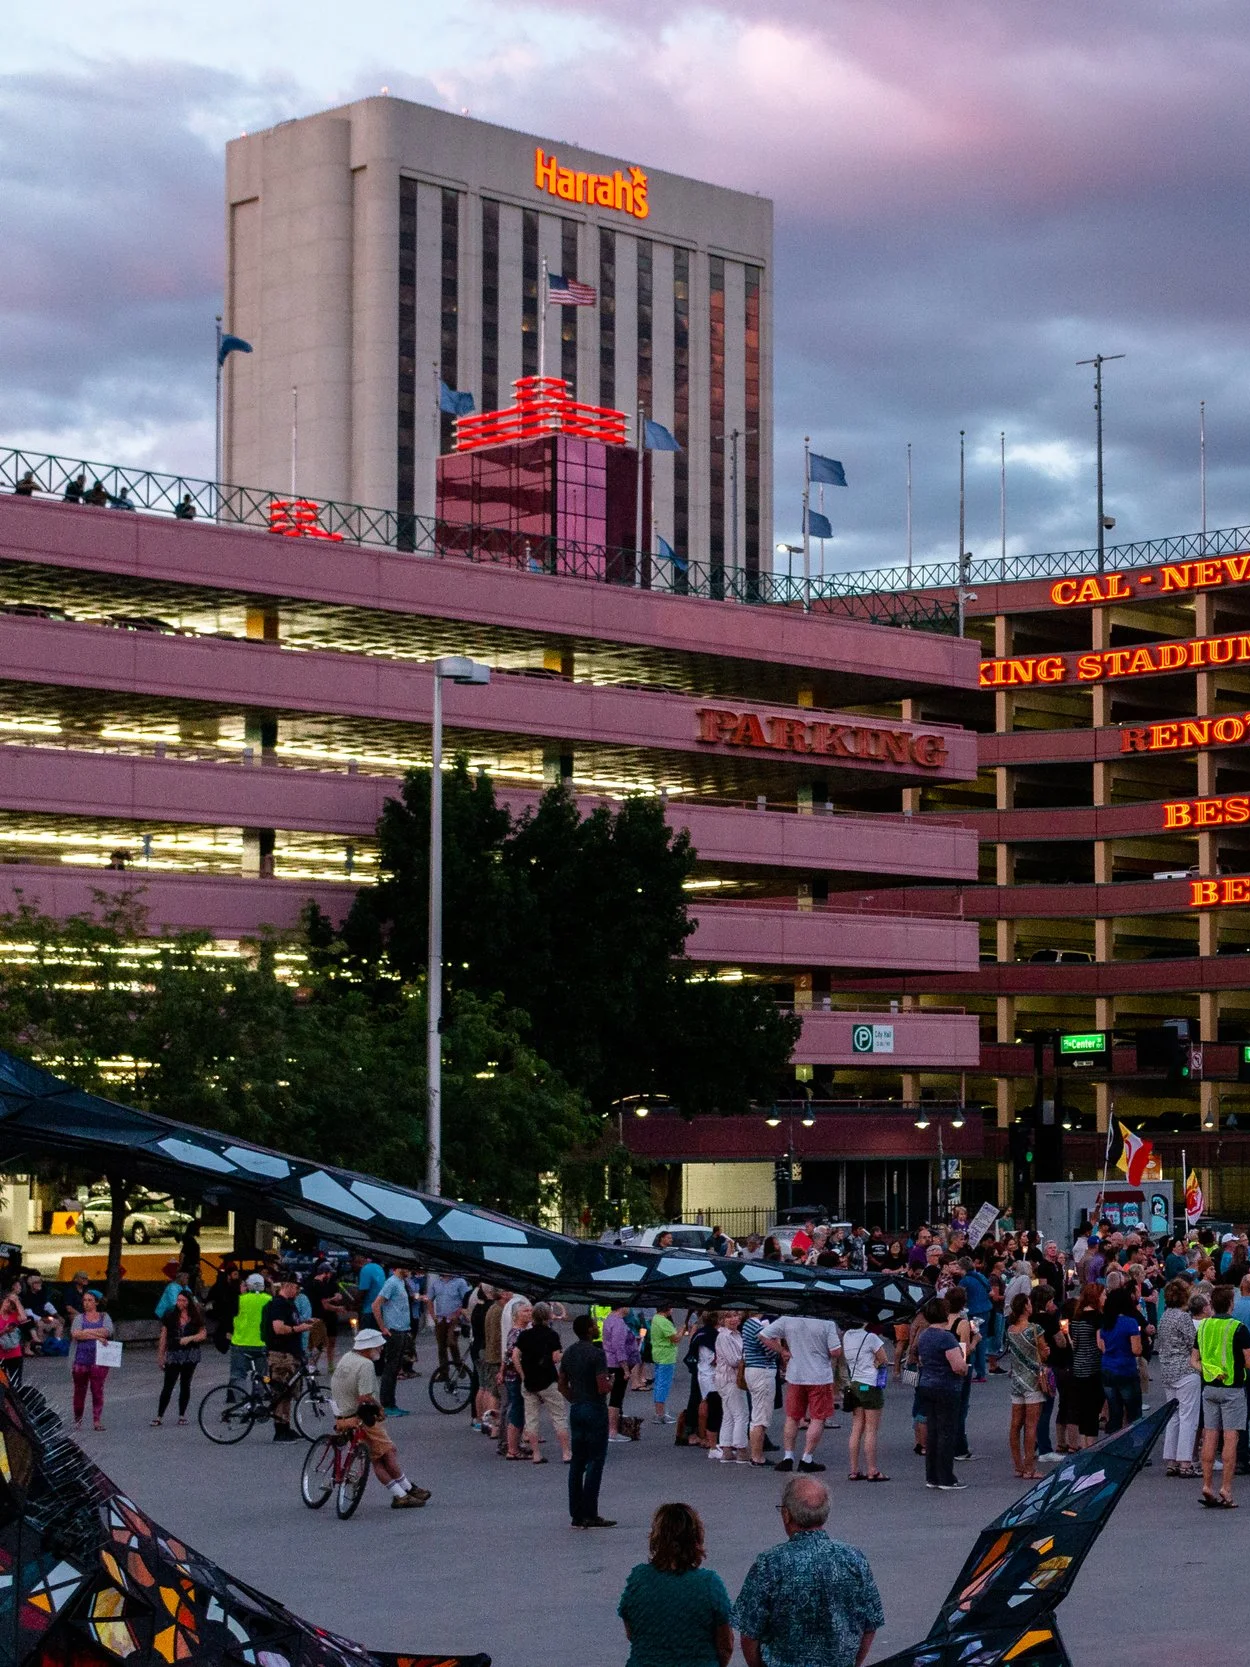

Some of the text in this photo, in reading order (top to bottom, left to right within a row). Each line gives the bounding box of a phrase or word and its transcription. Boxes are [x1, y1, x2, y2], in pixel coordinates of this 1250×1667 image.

[1051, 574, 1131, 606] CAL
[695, 707, 949, 768] PARKING
[1072, 1039, 1096, 1049] Center
